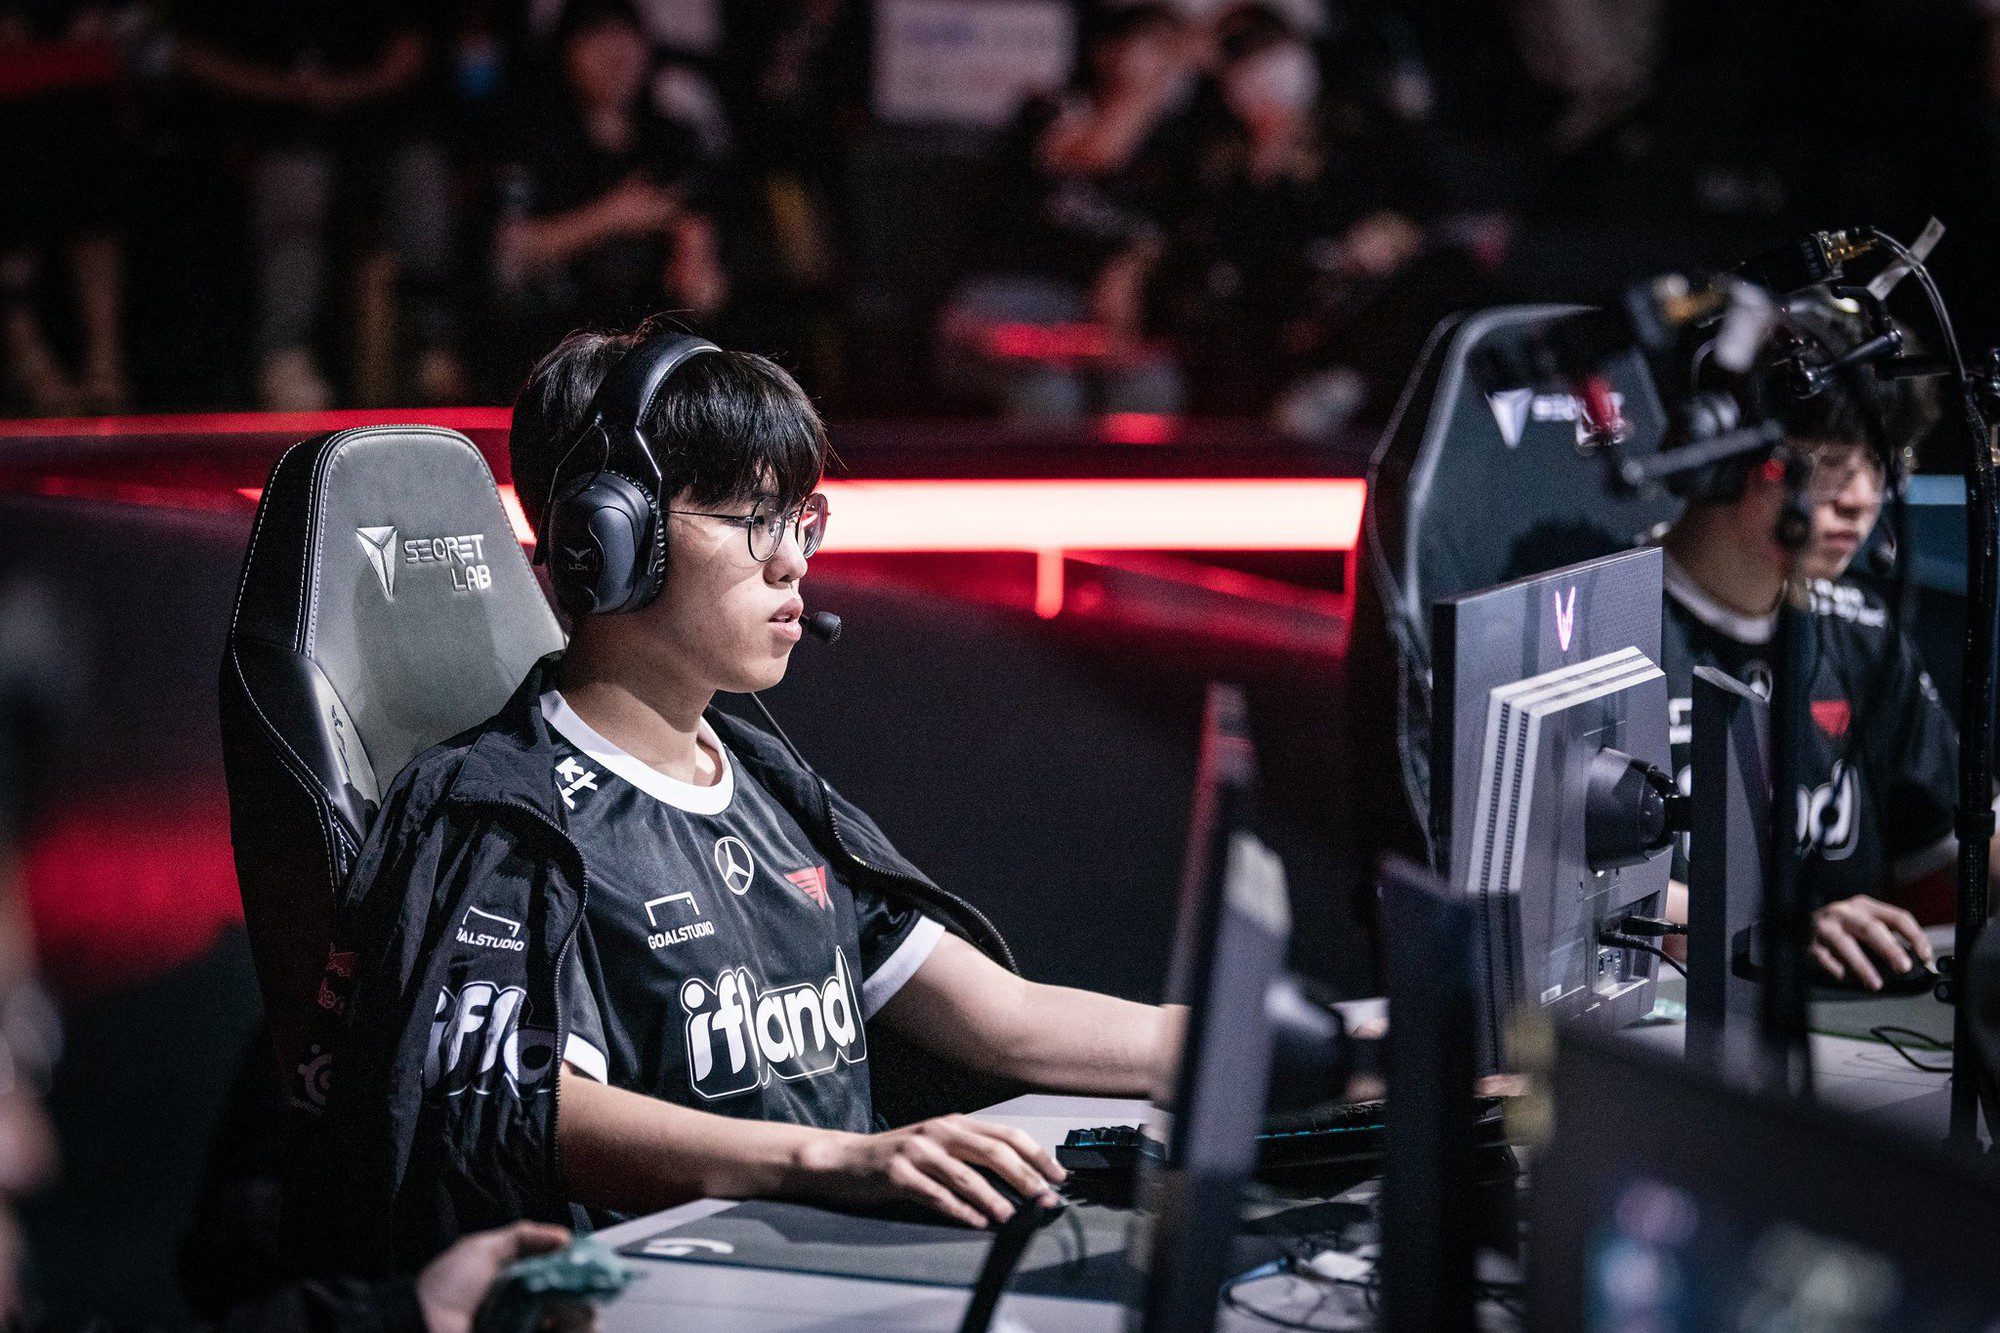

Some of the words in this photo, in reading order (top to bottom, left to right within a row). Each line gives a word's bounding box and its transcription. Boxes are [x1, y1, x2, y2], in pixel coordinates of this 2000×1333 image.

[403, 533, 485, 565] SECRET
[451, 564, 493, 592] LAB
[455, 928, 526, 952] ALSTUDIO
[647, 920, 715, 950] GOALSTUDIO
[685, 945, 861, 1088] ifland
